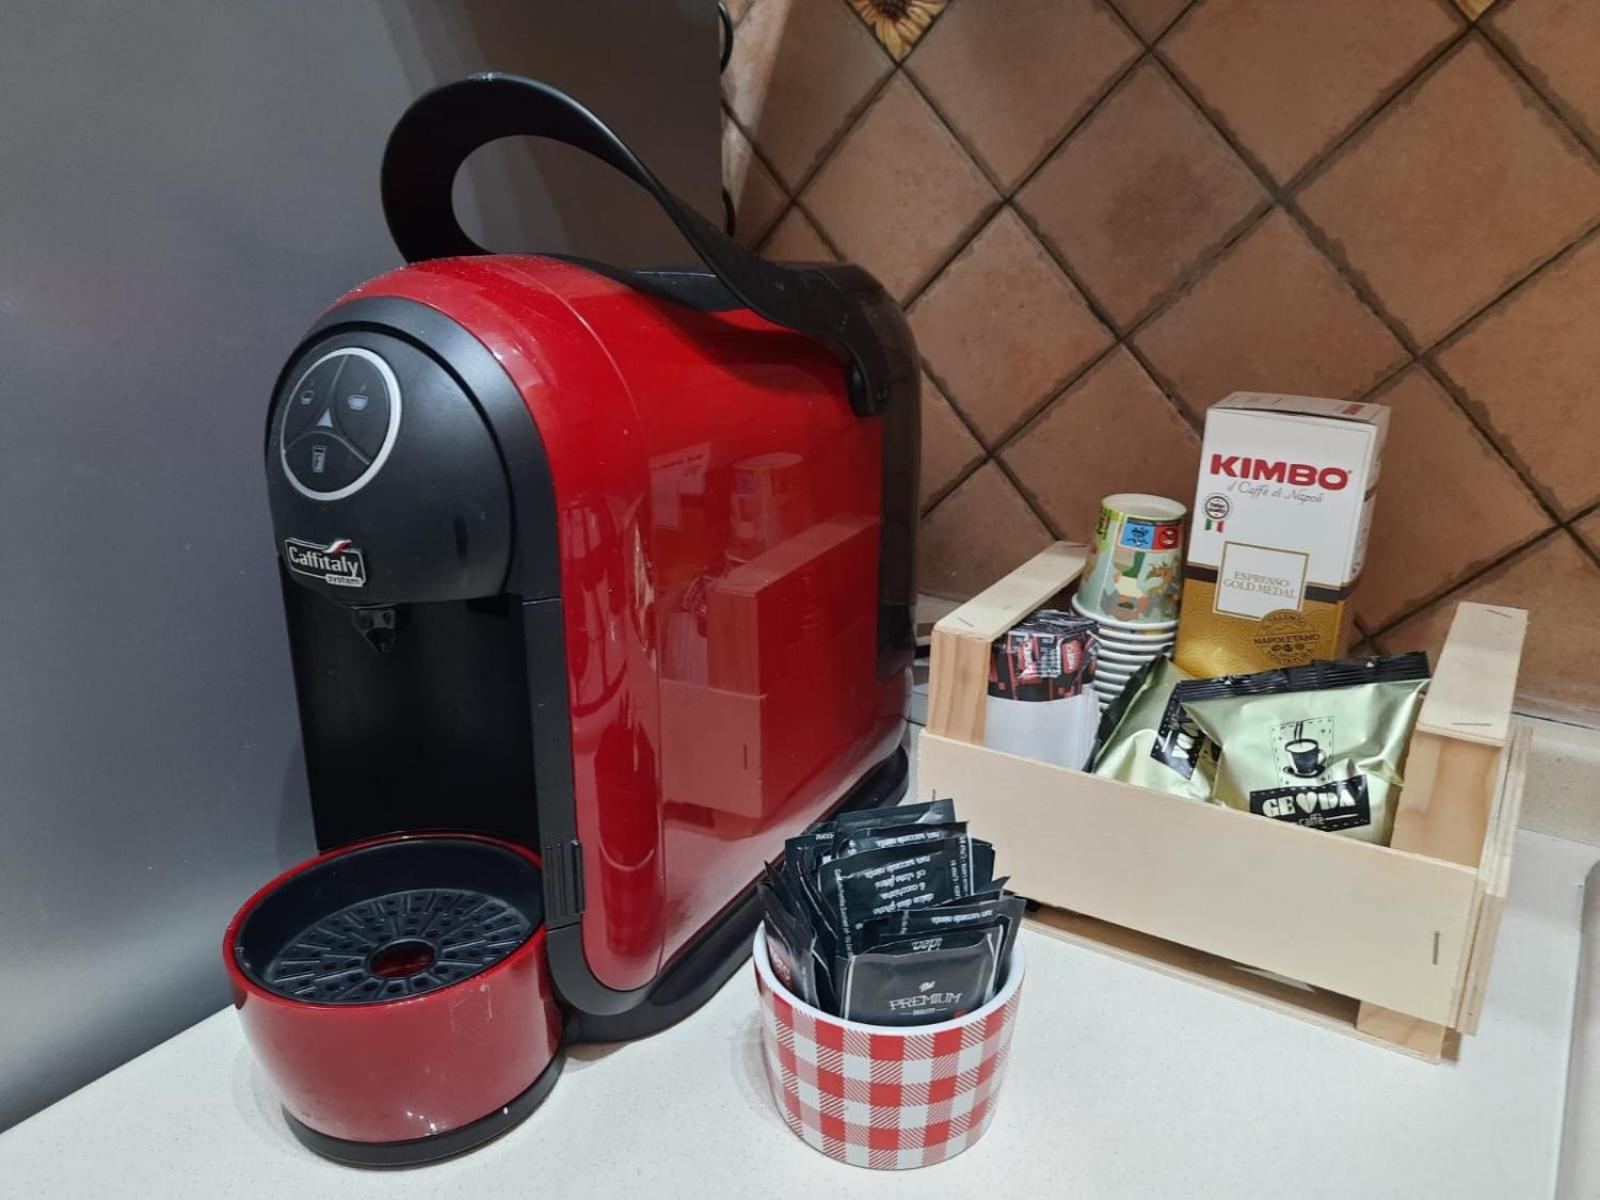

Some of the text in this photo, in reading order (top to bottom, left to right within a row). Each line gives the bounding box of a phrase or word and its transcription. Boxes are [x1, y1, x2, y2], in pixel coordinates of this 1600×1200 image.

[1210, 453, 1348, 491] KIMBO
[288, 546, 358, 578] Caffitaly
[1223, 578, 1297, 599] GOLD MEDAL
[1232, 571, 1290, 588] ESPRESSO
[1253, 632, 1322, 645] NAPOLETANO
[889, 992, 963, 1011] PREMIUM
